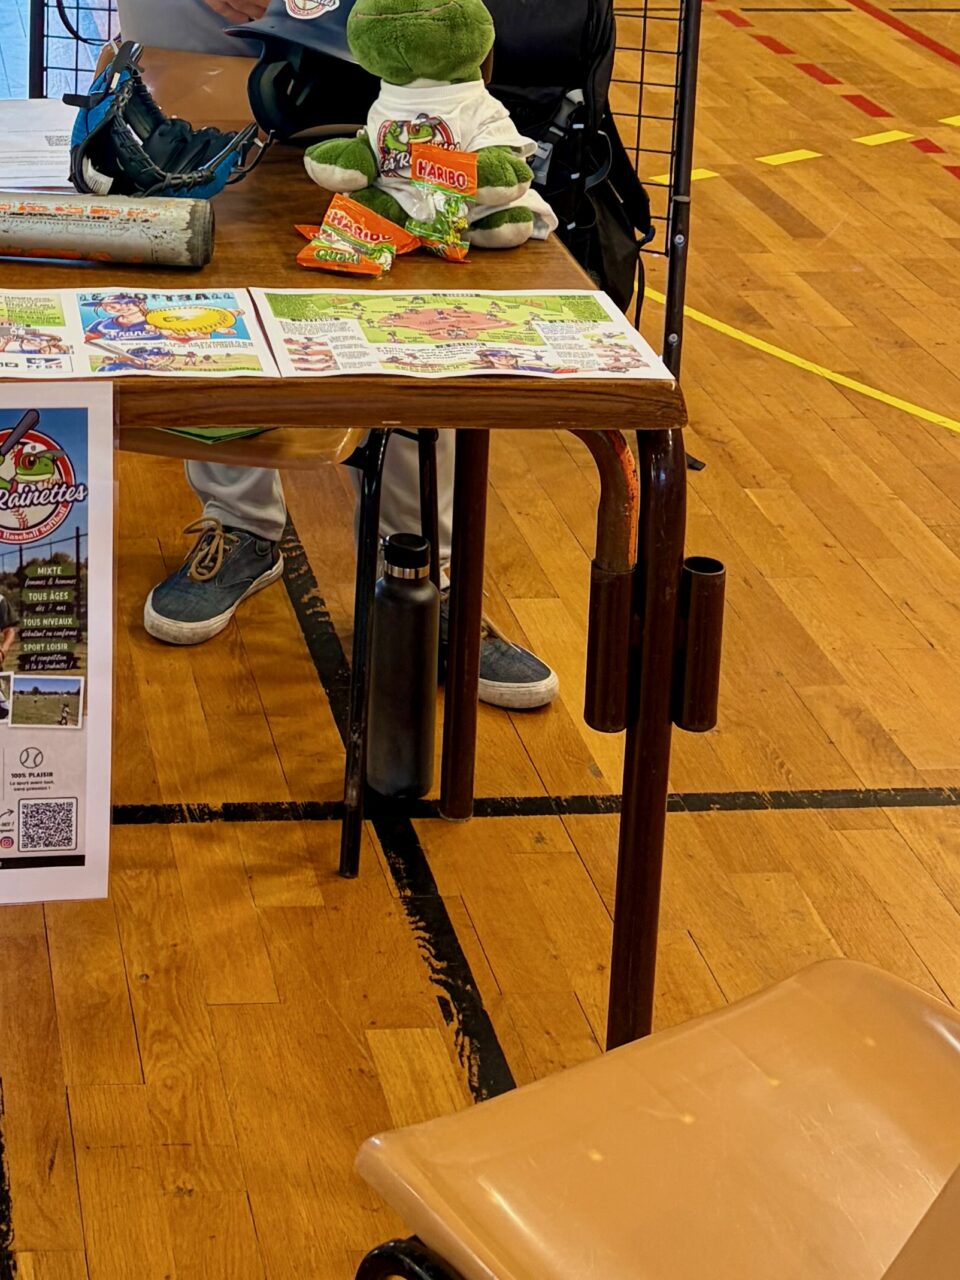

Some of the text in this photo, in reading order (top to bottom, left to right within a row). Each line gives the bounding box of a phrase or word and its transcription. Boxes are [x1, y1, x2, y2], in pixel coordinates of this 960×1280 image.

[417, 159, 468, 189] HARIBO
[2, 531, 41, 542] Baseball
[37, 566, 62, 575] MIXTE
[28, 591, 69, 601] TOUS ÂGES
[23, 618, 73, 627] TOUS NIVEAUX
[23, 642, 68, 652] SPORT LOISIR
